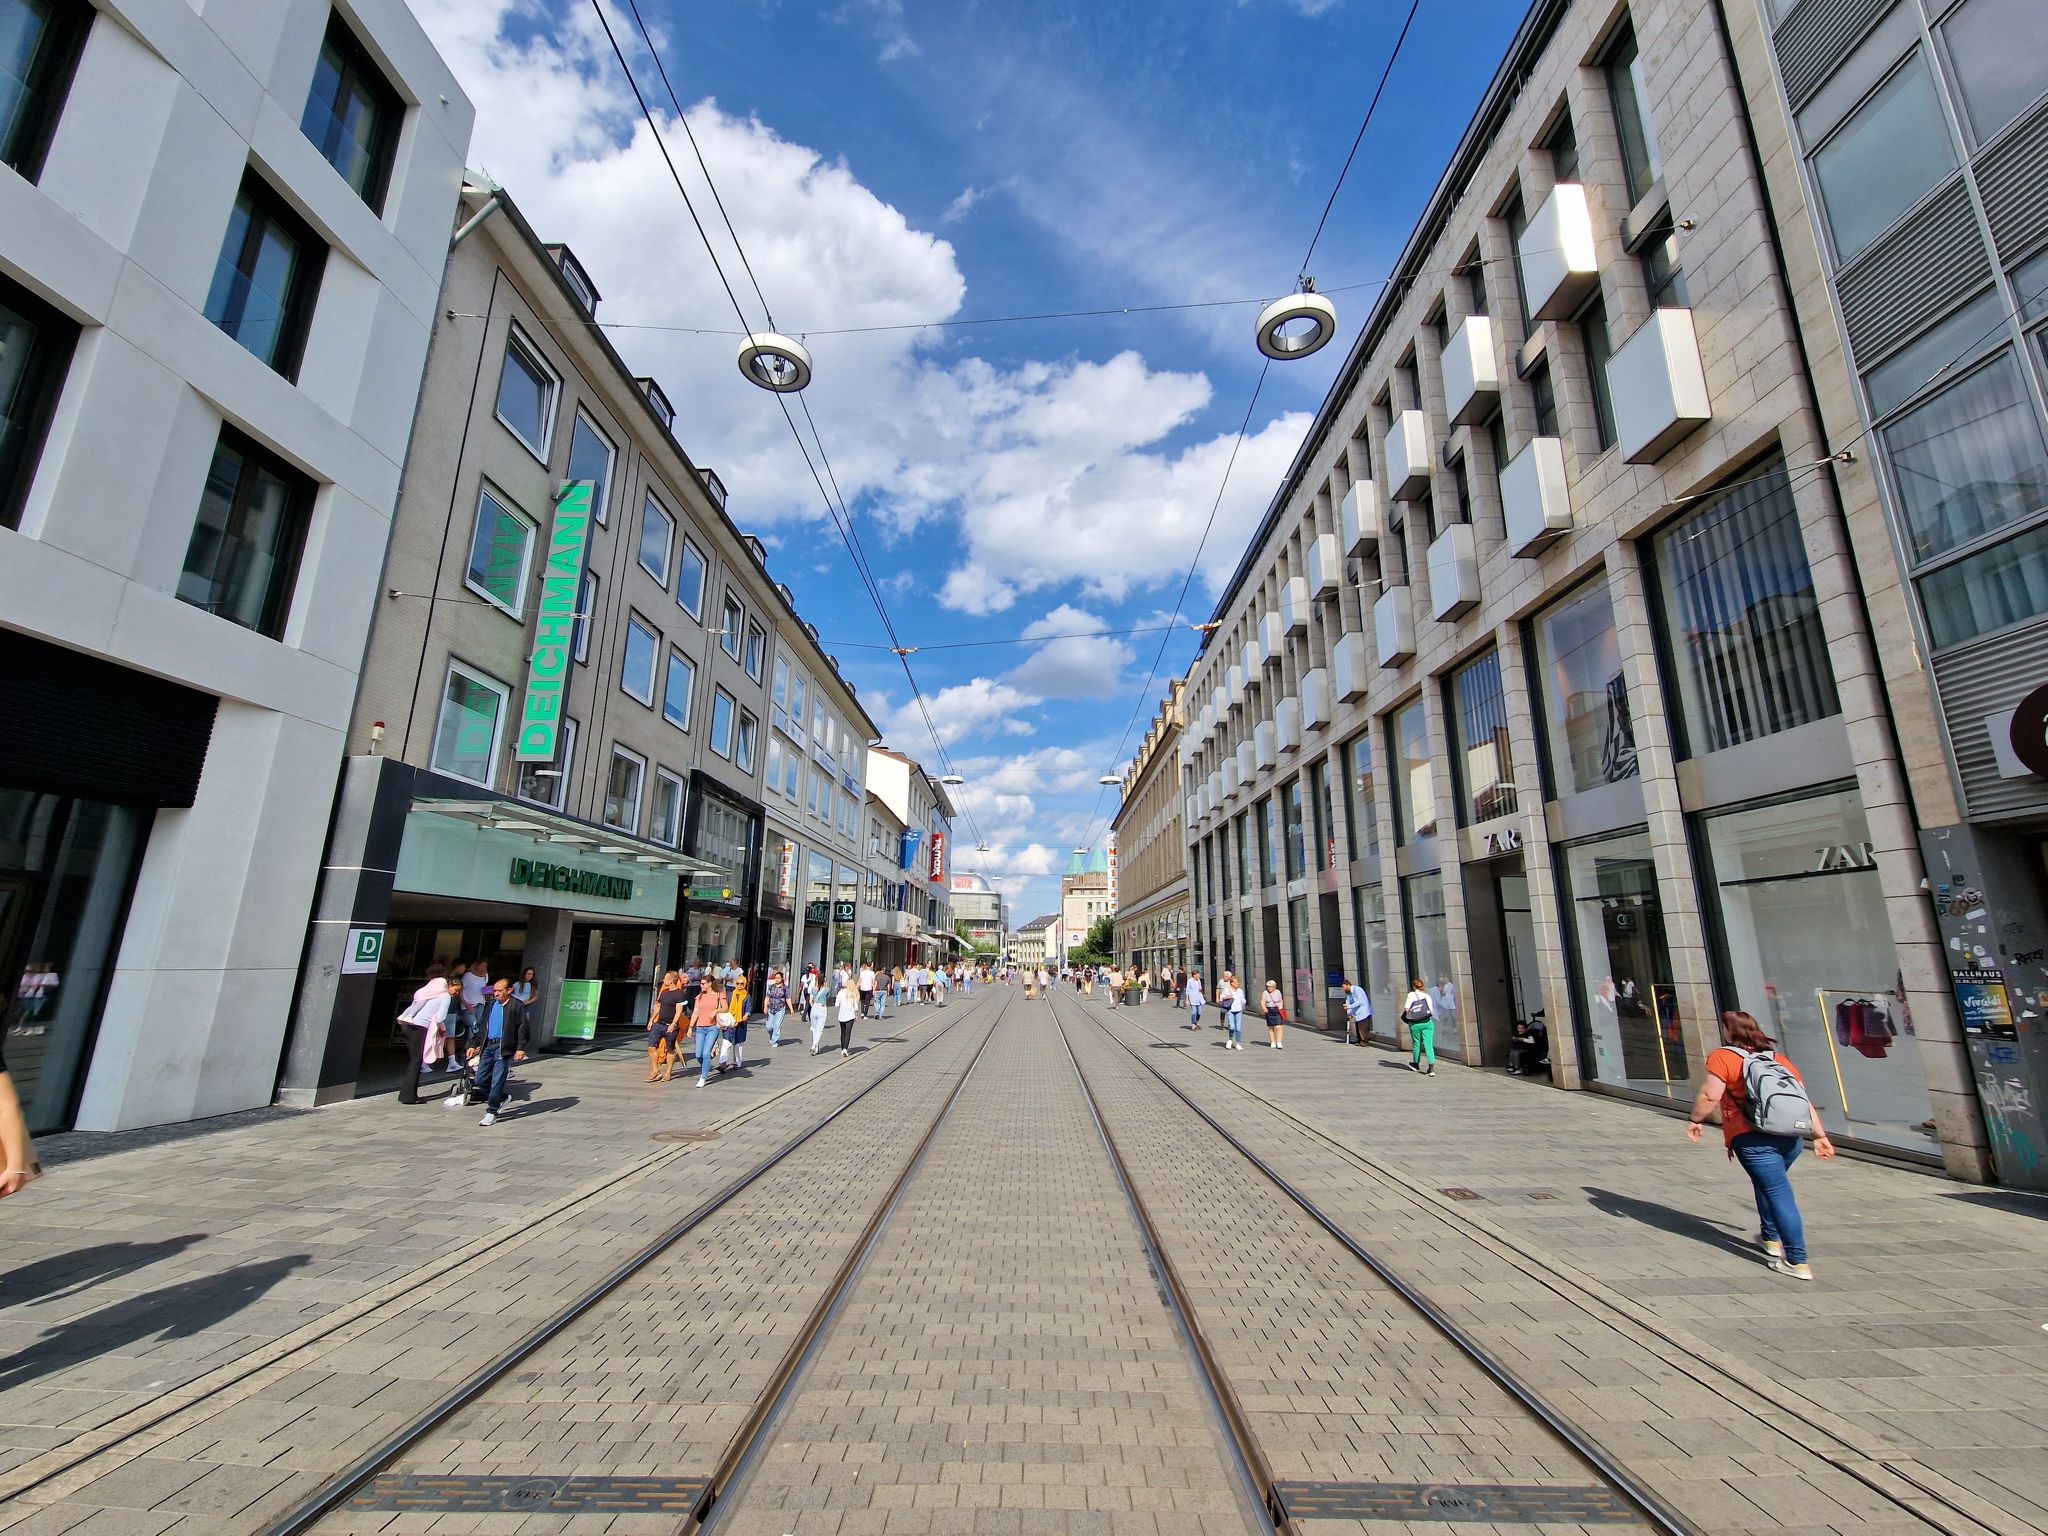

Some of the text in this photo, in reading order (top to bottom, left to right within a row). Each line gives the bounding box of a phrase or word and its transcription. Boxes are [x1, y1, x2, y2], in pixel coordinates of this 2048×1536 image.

[519, 484, 591, 756] DEICHMANN
[509, 858, 633, 900] DEICHMANN
[362, 937, 377, 953] D
[1953, 970, 2001, 978] BALLHAUS
[564, 1000, 592, 1010] -20%
[1963, 993, 2002, 1008] Vivaldi
